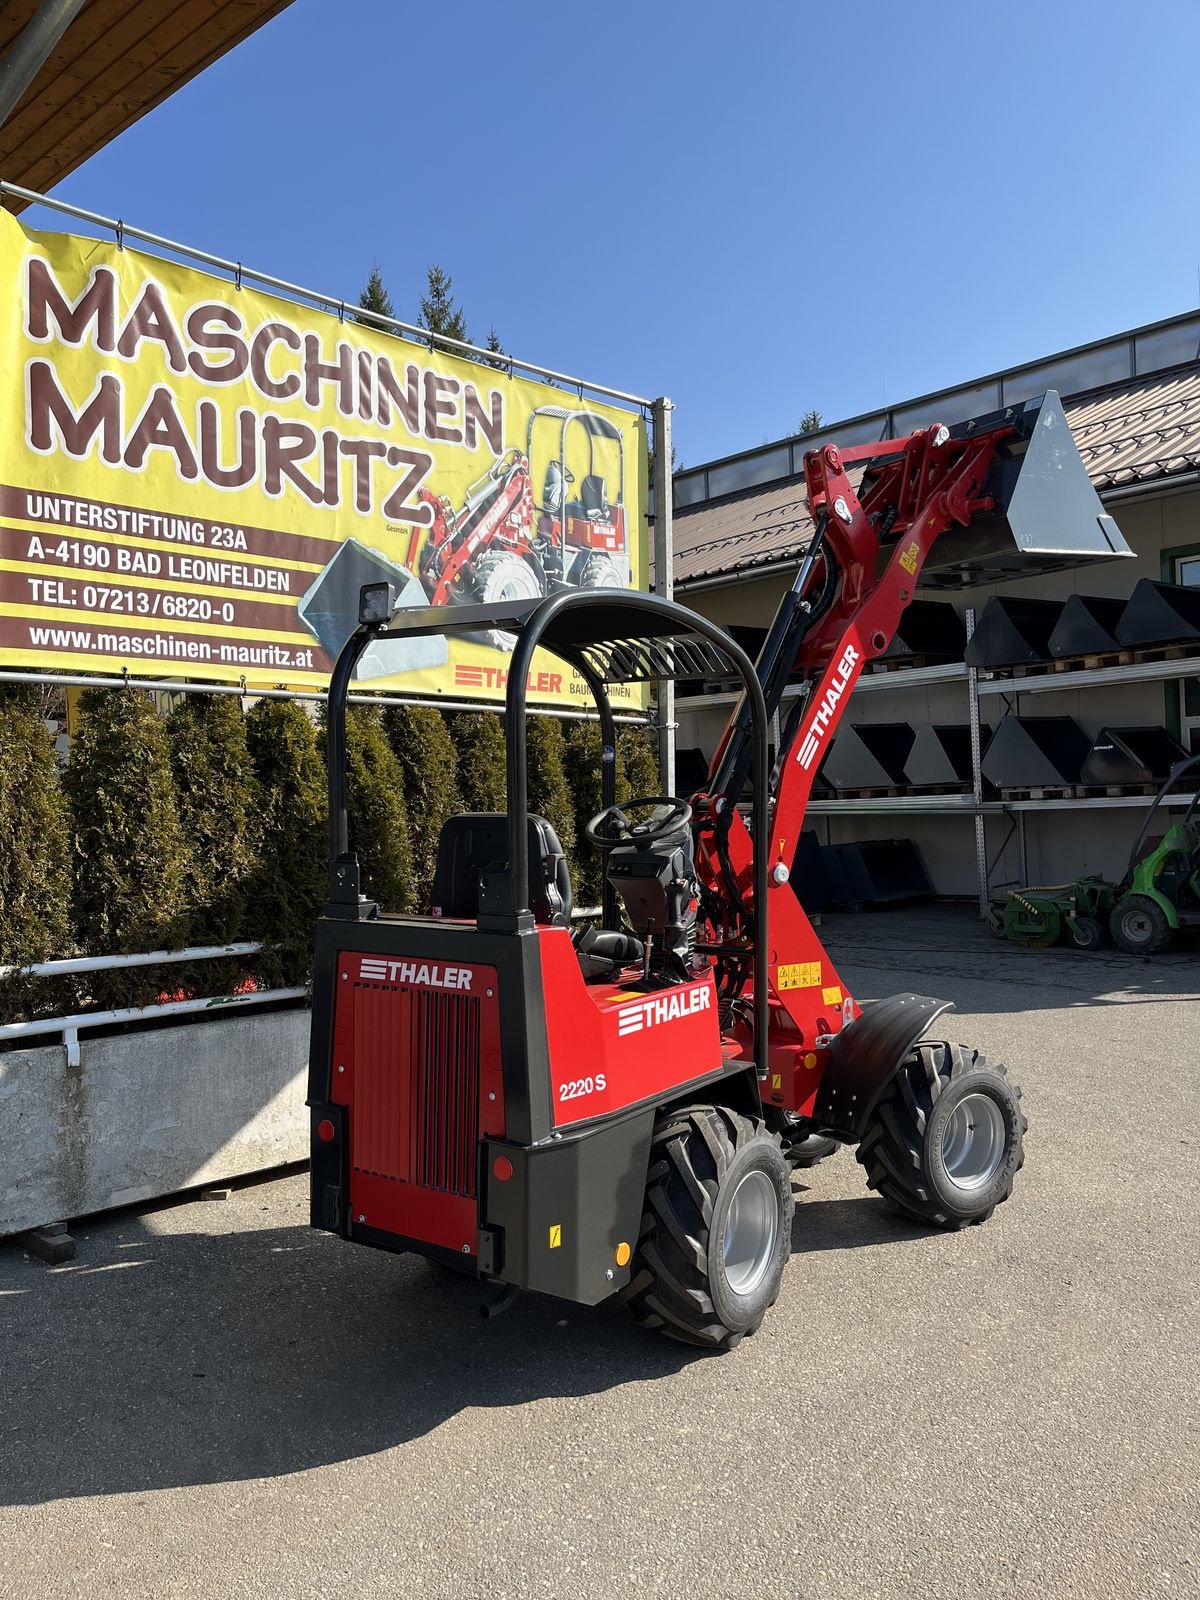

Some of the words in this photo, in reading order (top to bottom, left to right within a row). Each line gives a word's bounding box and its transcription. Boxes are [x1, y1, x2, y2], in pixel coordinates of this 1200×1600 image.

[28, 258, 503, 456] MASCHINEN
[29, 361, 433, 525] MAURITZ
[27, 495, 205, 544] UNTERSTIFTUNG
[211, 525, 248, 550] 23A
[386, 524, 408, 535] GesmbH
[27, 536, 110, 568] A-4190
[117, 549, 161, 575] BAD
[168, 556, 290, 592] LEONFELDEN
[28, 578, 77, 605] TEL:
[83, 586, 235, 623] 07213/6820-0
[29, 627, 314, 668] www.maschinen-mauritz.at
[482, 667, 562, 693] THLER
[809, 644, 860, 737] THALER
[387, 961, 473, 990] THALER
[643, 986, 711, 1028] THALER
[559, 1077, 594, 1101] 2220
[595, 1073, 607, 1091] S
